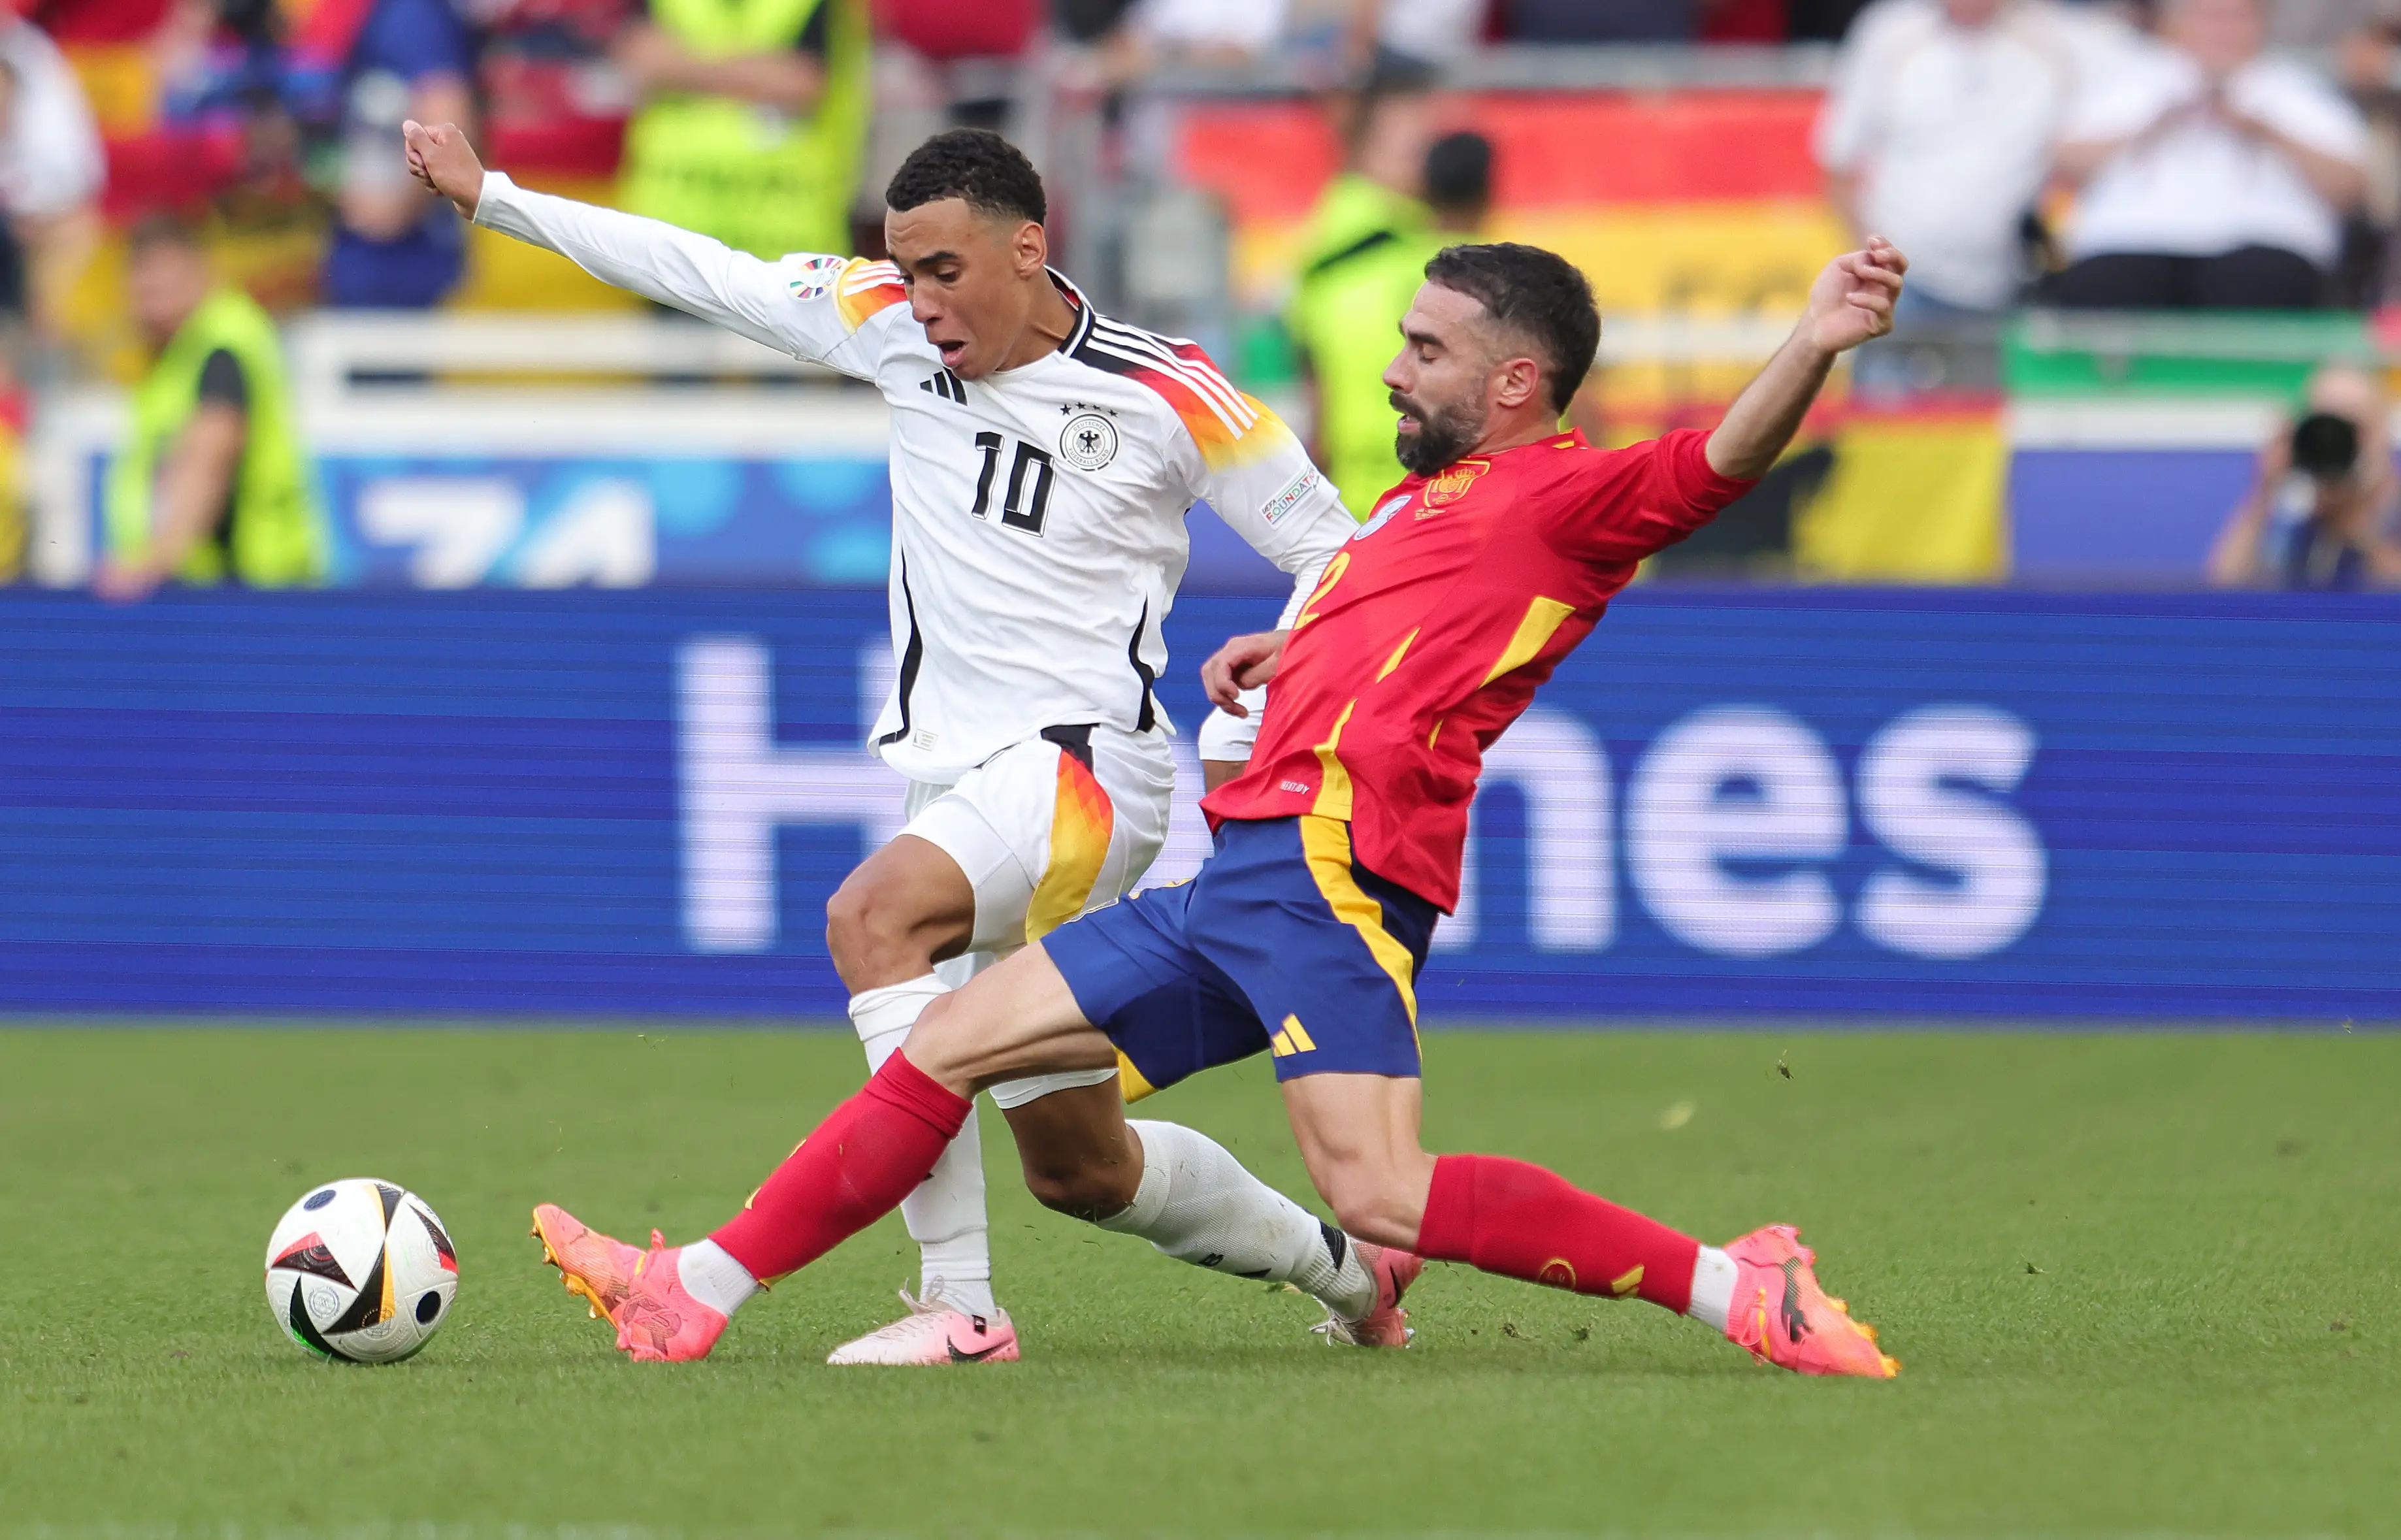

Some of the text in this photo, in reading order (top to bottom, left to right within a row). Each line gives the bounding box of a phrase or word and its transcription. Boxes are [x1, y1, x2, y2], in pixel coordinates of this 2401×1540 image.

[1073, 421, 1106, 431] DEUTSCHER
[972, 431, 1056, 538] 10
[1262, 499, 1277, 514] UEFA
